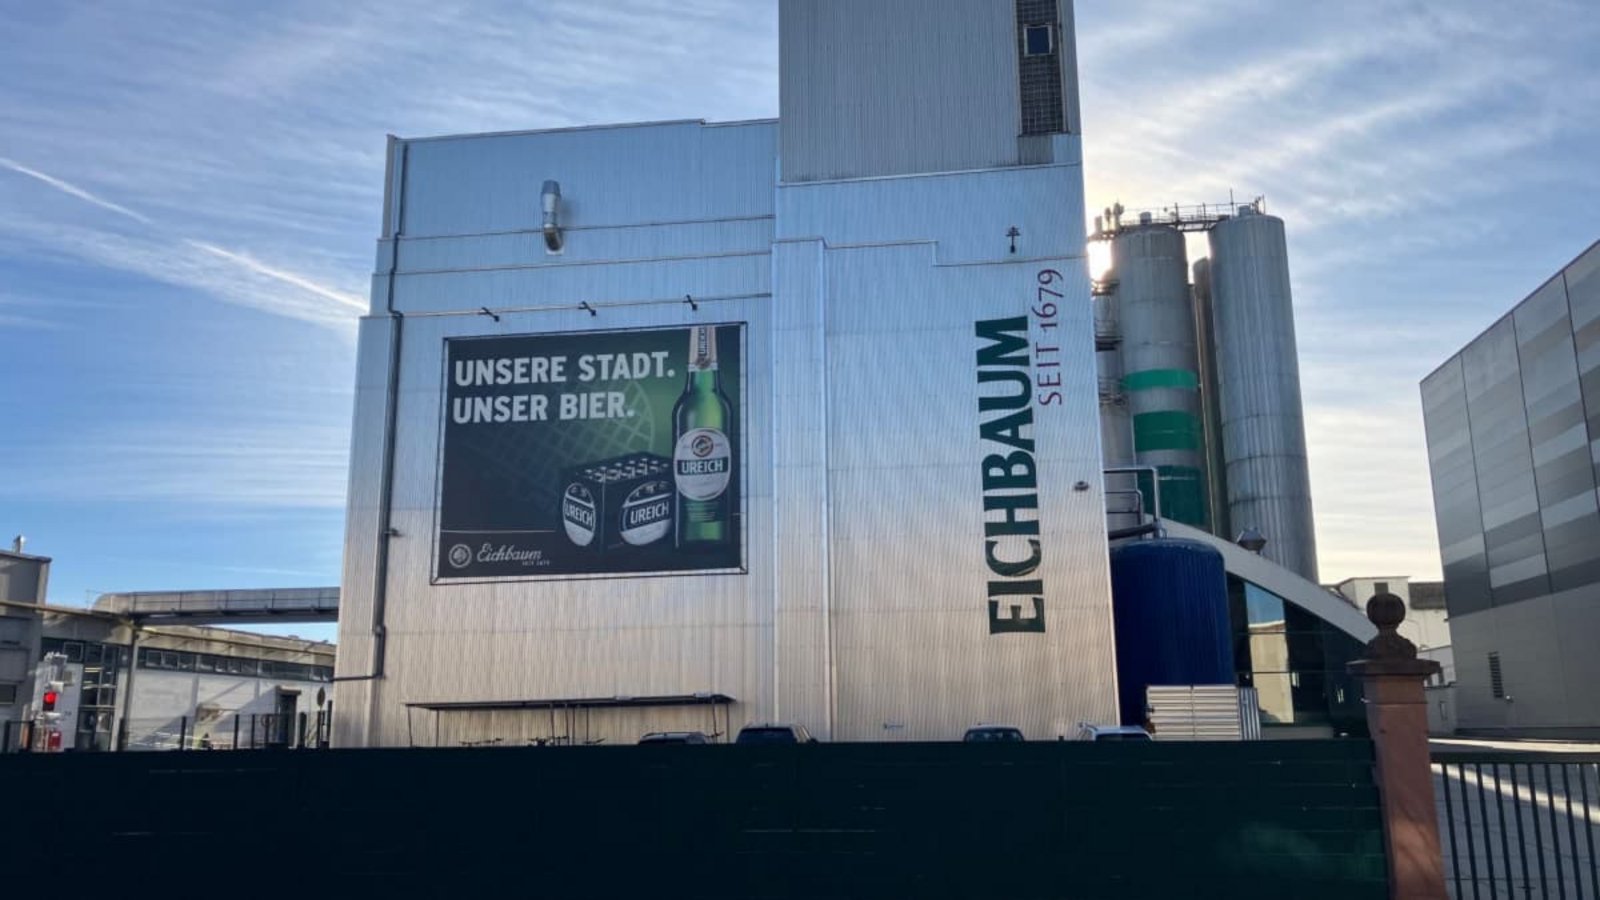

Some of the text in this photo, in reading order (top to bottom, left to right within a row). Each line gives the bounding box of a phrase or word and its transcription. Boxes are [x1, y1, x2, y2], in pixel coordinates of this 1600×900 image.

[1031, 269, 1064, 406] SEIT 1679
[455, 351, 676, 386] UNSERE STADT.
[453, 391, 635, 424] UNSER BIER.
[681, 459, 724, 474] UREICH
[975, 315, 1046, 635] EICHBAUM
[564, 499, 593, 527] UREICH
[630, 501, 669, 524] UREICH
[476, 542, 542, 562] Eichbaum
